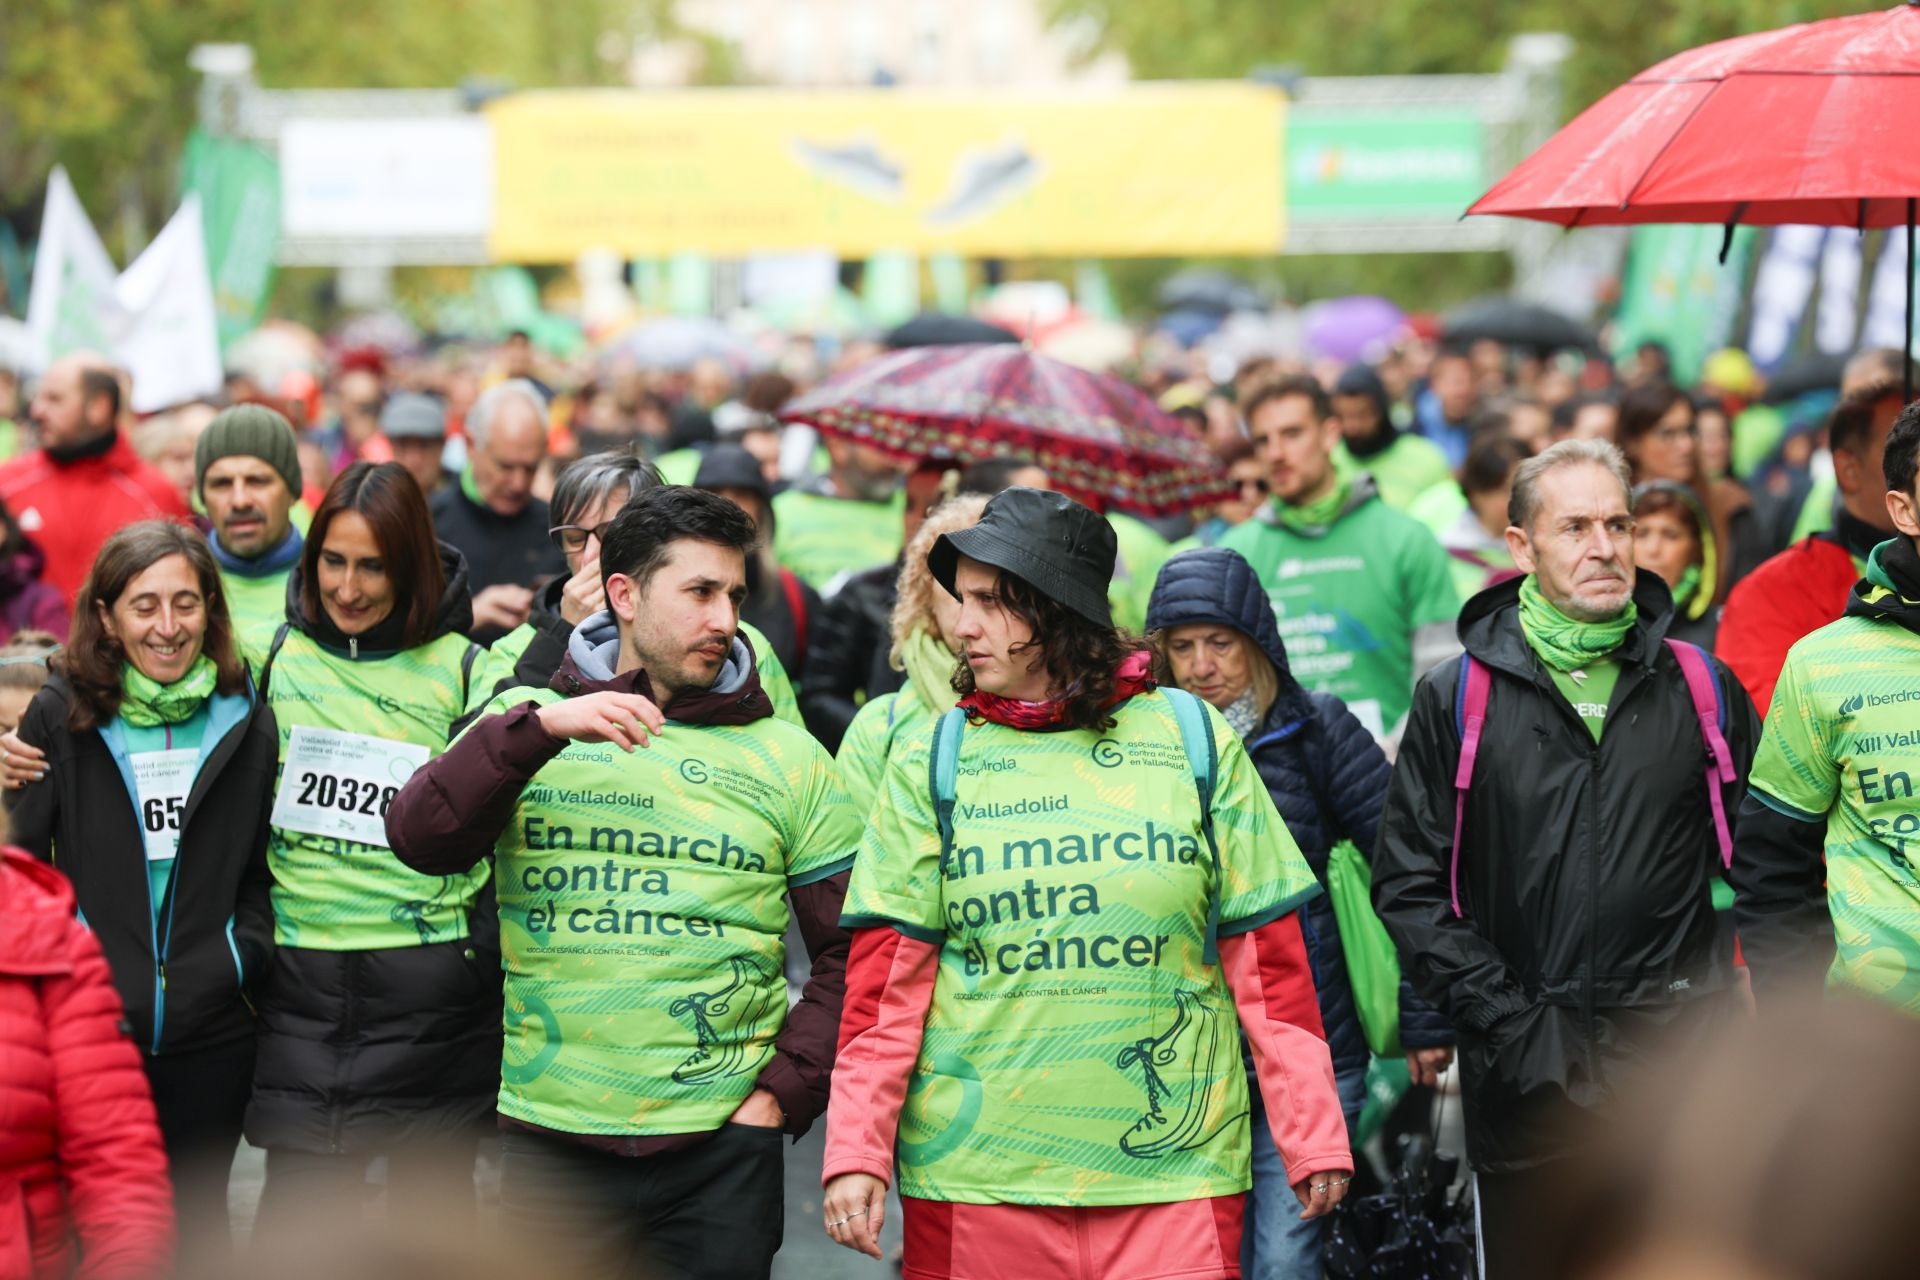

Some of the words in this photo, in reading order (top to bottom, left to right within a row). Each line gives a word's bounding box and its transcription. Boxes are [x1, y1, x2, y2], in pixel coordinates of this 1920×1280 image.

[553, 751, 613, 762] berdrola
[1129, 749, 1156, 758] contra
[1174, 744, 1185, 752] es
[1854, 736, 1881, 755] XIII
[1885, 729, 1920, 748] Vall
[297, 772, 400, 819] 20328
[529, 789, 553, 803] XIII
[558, 789, 654, 808] Valladolid
[1858, 767, 1913, 804] En
[144, 796, 185, 832] 65
[961, 794, 1069, 820] Valladolid
[524, 817, 573, 850] En
[589, 826, 766, 873] marcha
[1003, 821, 1199, 870] marcha
[522, 859, 669, 896] contra
[526, 899, 557, 933] el
[568, 899, 729, 938] cáncer
[947, 879, 1100, 931] contra
[593, 948, 625, 956] CONTRA
[963, 938, 989, 977] el
[996, 928, 1169, 975] cáncer
[1025, 988, 1060, 998] CONTRA
[1061, 987, 1071, 996] EL
[1072, 985, 1107, 996] CÁNCER
